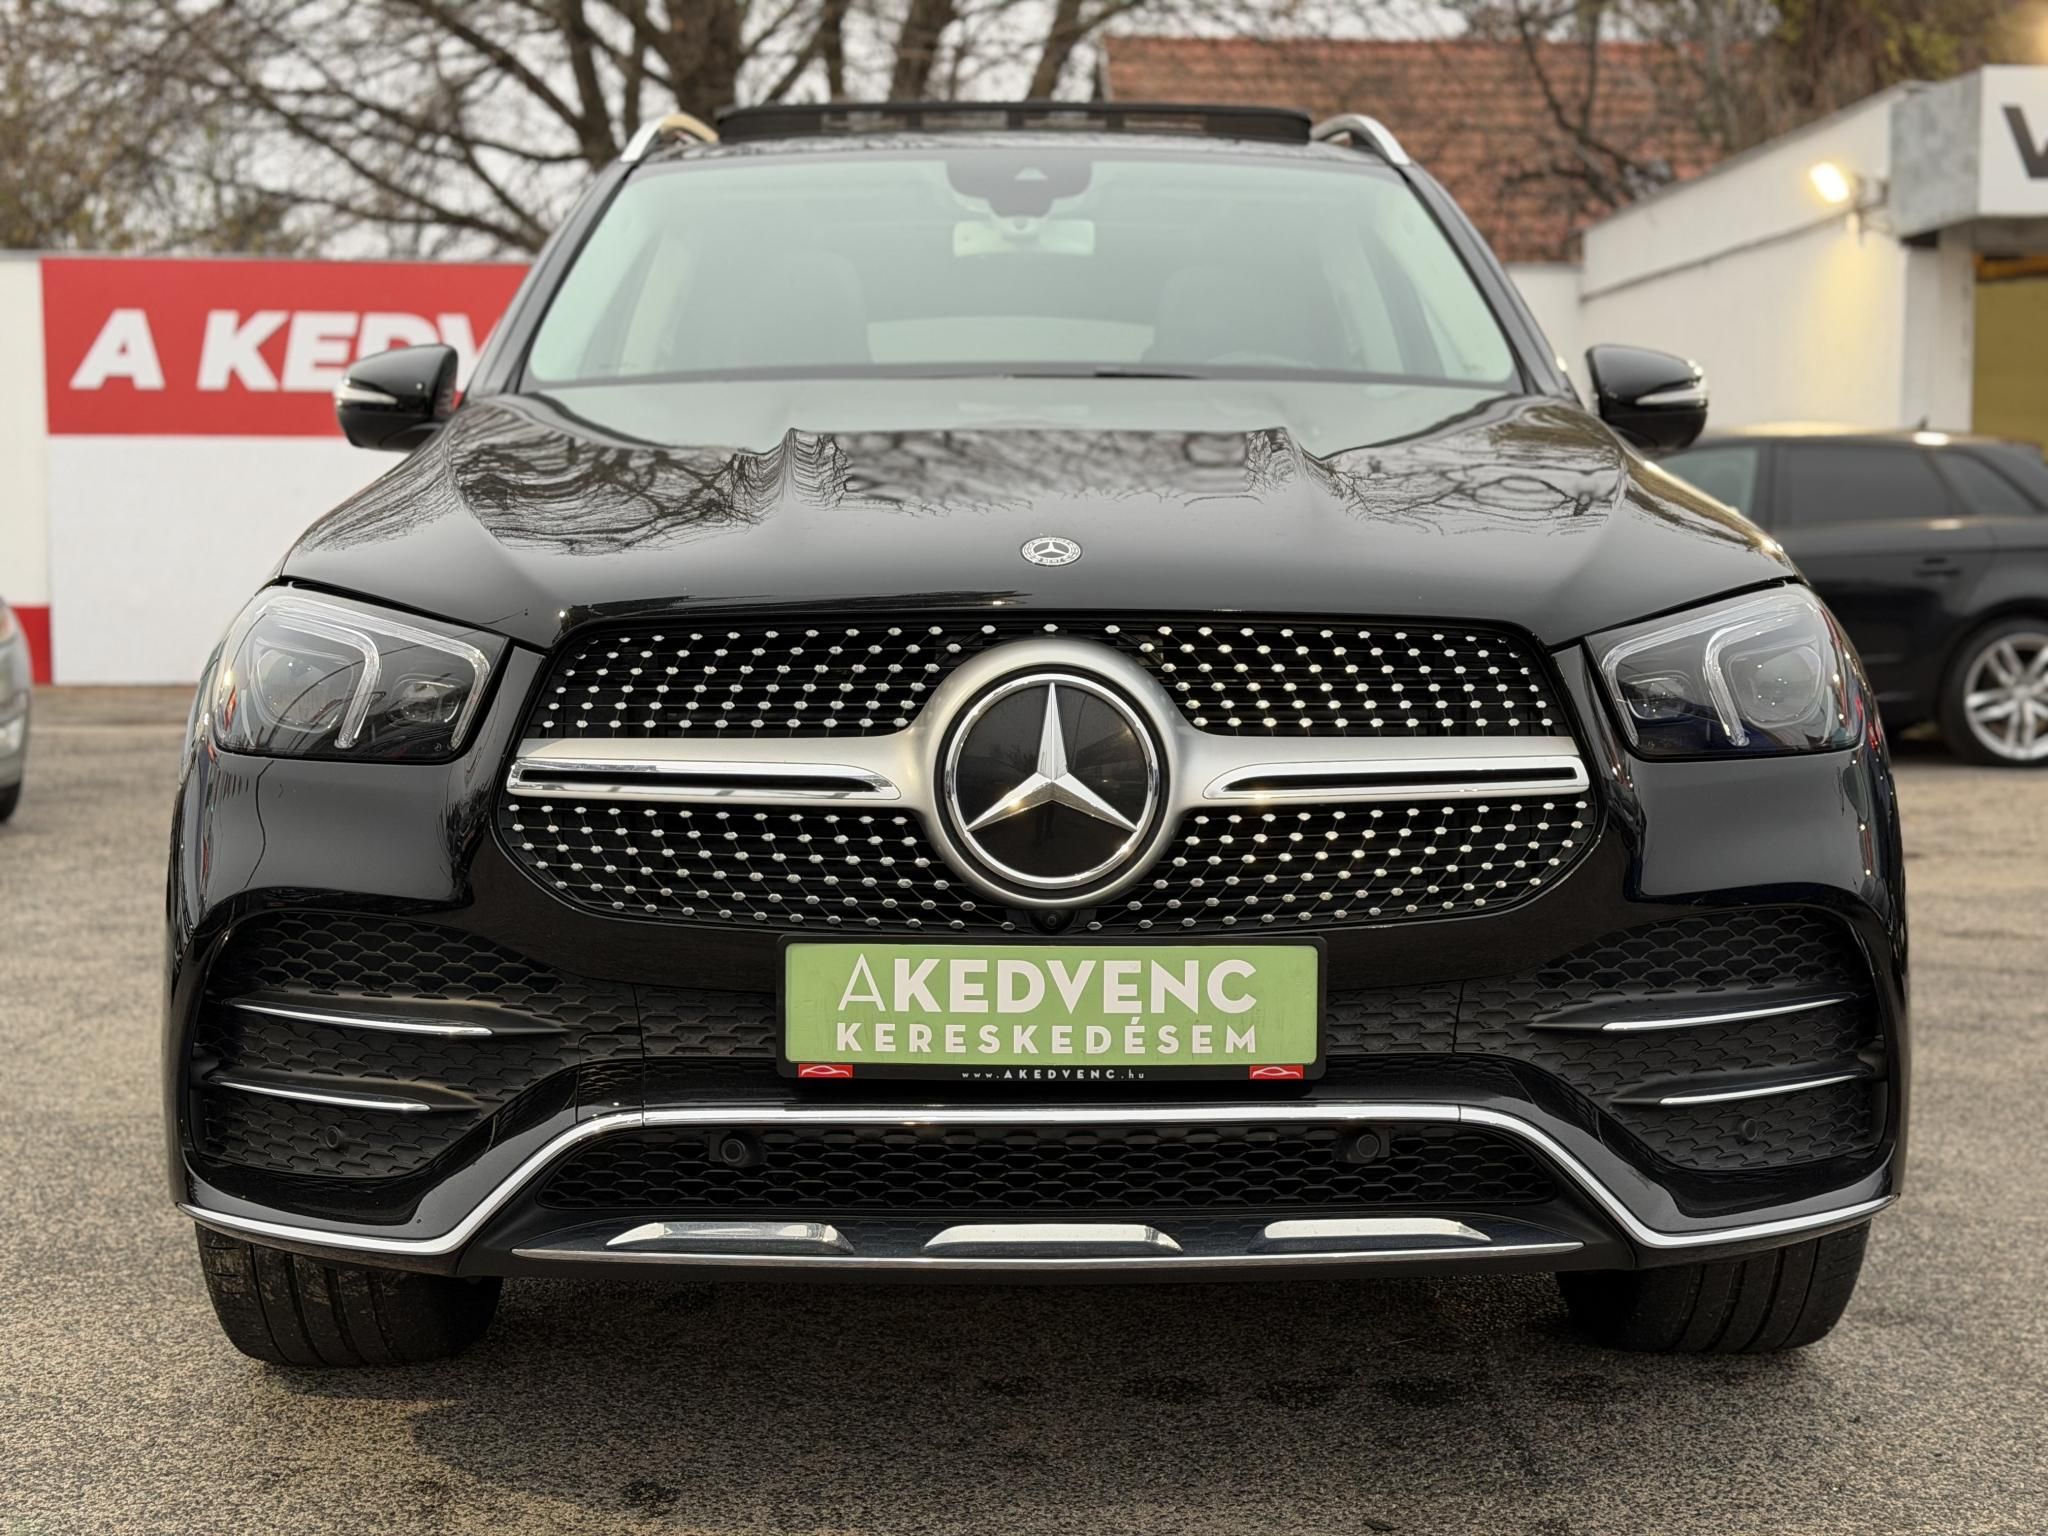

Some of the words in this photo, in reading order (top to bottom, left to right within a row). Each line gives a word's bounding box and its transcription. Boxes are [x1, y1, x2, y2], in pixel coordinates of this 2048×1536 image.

[69, 308, 165, 390] A
[837, 1017, 1257, 1054] KERESKEDÉSEM
[962, 1069, 1144, 1079] www.AKEDVENC.hu
